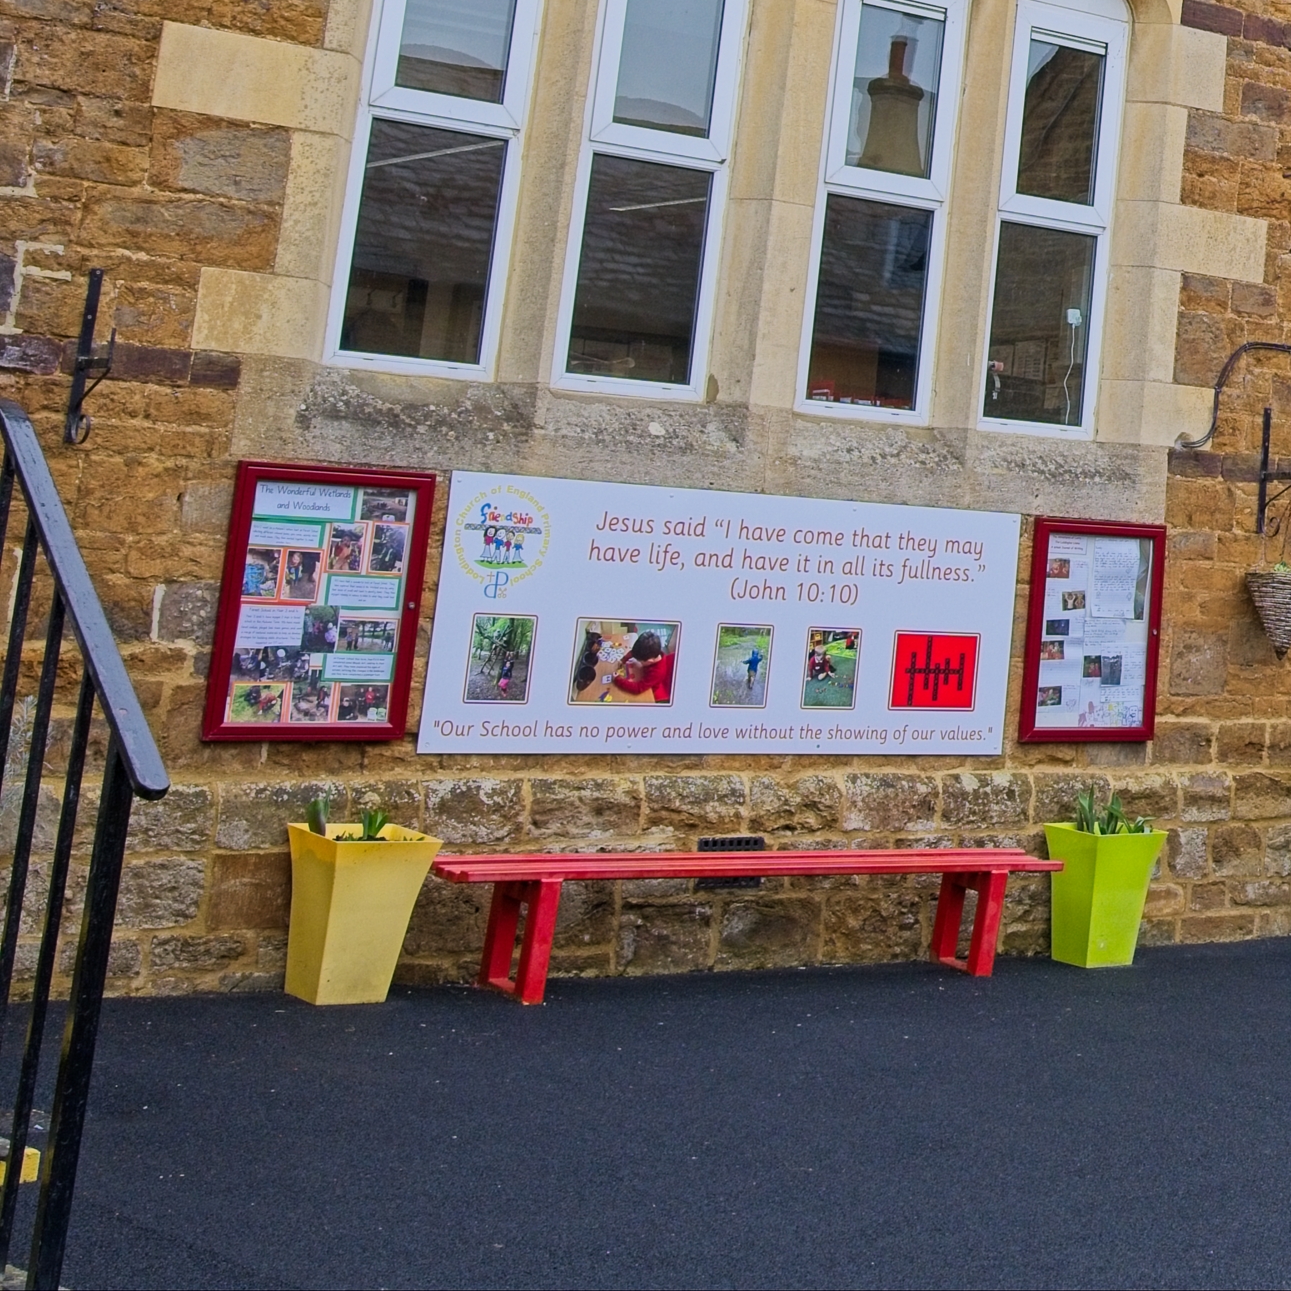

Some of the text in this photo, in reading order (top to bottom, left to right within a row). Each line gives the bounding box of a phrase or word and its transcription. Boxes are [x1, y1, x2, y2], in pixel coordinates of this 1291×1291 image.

[260, 484, 352, 498] The Wonderful Wetlands
[276, 500, 331, 512] and Woodlands
[453, 485, 552, 587] Loddington Church of England Primary School
[596, 511, 655, 534] Jesus
[662, 515, 707, 538] said
[738, 518, 786, 543] have
[793, 528, 845, 547] come
[851, 527, 892, 550] that
[898, 530, 938, 558] they
[944, 538, 984, 561] may
[588, 538, 641, 564] have
[648, 542, 685, 572] life,
[694, 547, 734, 569] and
[741, 548, 790, 572] have
[796, 553, 811, 573] it
[817, 555, 835, 575] in
[841, 555, 866, 576] all
[872, 558, 894, 578] its
[730, 577, 859, 606] (John 10:10)
[433, 720, 993, 745] "Our School has no power and love without the showing of our values."
